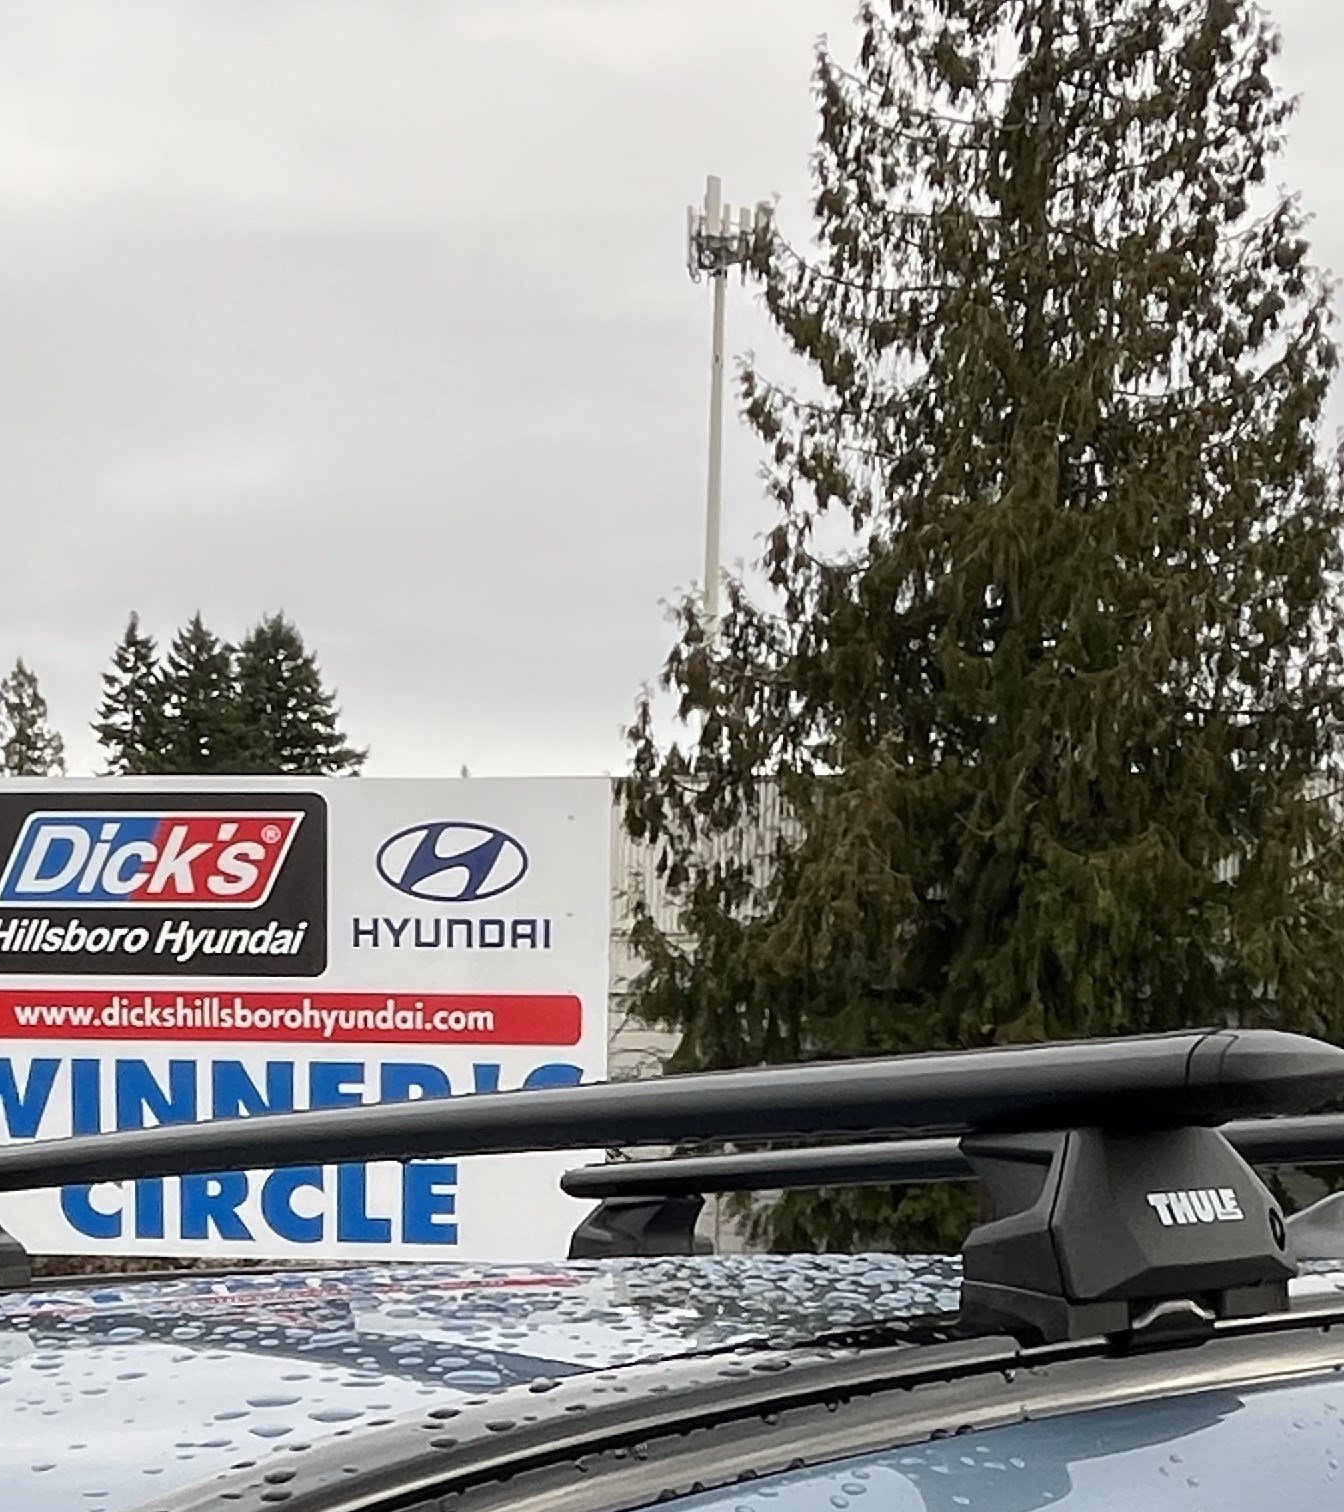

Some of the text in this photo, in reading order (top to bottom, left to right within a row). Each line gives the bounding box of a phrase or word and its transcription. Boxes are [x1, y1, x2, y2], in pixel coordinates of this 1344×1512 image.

[155, 920, 307, 962] Hyundai
[353, 918, 551, 949] HYUNDAI
[15, 997, 494, 1037] www.dickshillsborohyundai.com
[60, 1163, 458, 1245] CIRCLE
[1147, 1188, 1244, 1226] THULE
